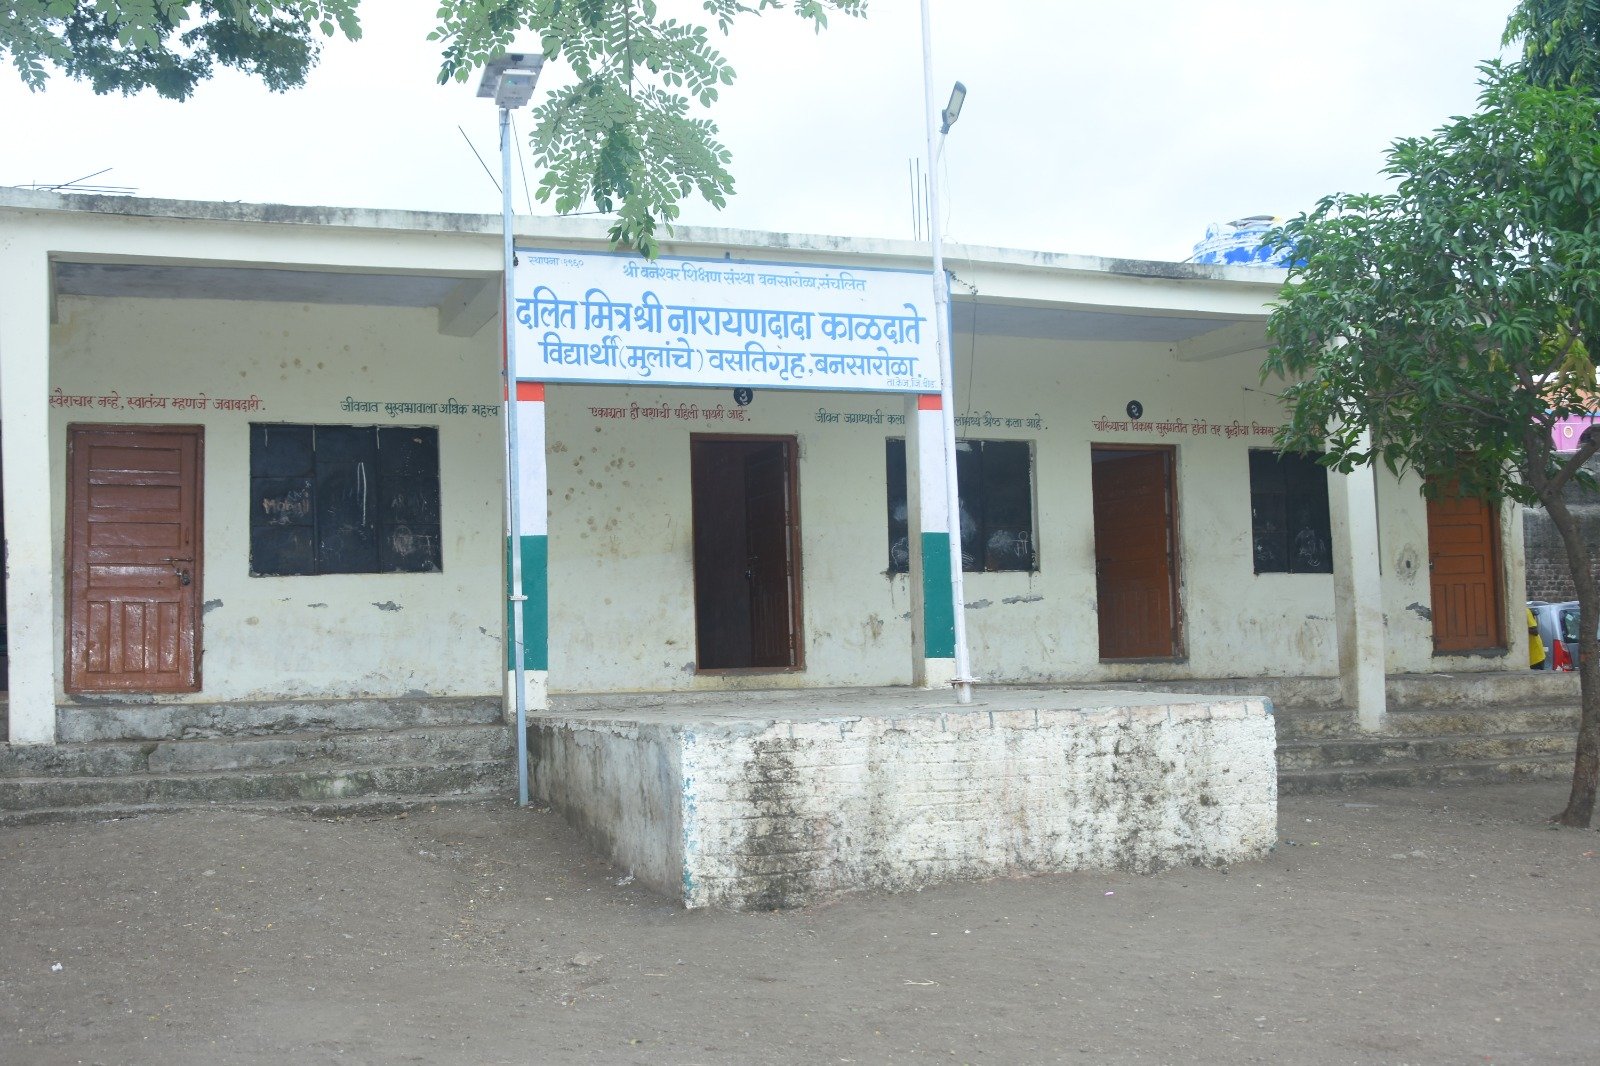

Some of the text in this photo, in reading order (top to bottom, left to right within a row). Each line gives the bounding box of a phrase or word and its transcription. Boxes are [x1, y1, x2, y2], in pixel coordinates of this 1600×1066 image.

[623, 261, 641, 276] श्री
[681, 262, 722, 283] शिक्षण
[723, 268, 754, 285] संस्था
[819, 272, 867, 292] संचलित
[515, 285, 578, 330] दलित
[665, 305, 816, 341] नारायणदादा
[819, 303, 927, 345] काळदाते
[97, 390, 124, 411] नव्हे,
[171, 393, 210, 410] म्हणजे
[340, 396, 383, 413] जीवनात
[437, 397, 469, 415] अधिक
[674, 402, 700, 420] पहिली
[815, 407, 841, 423] जीवन
